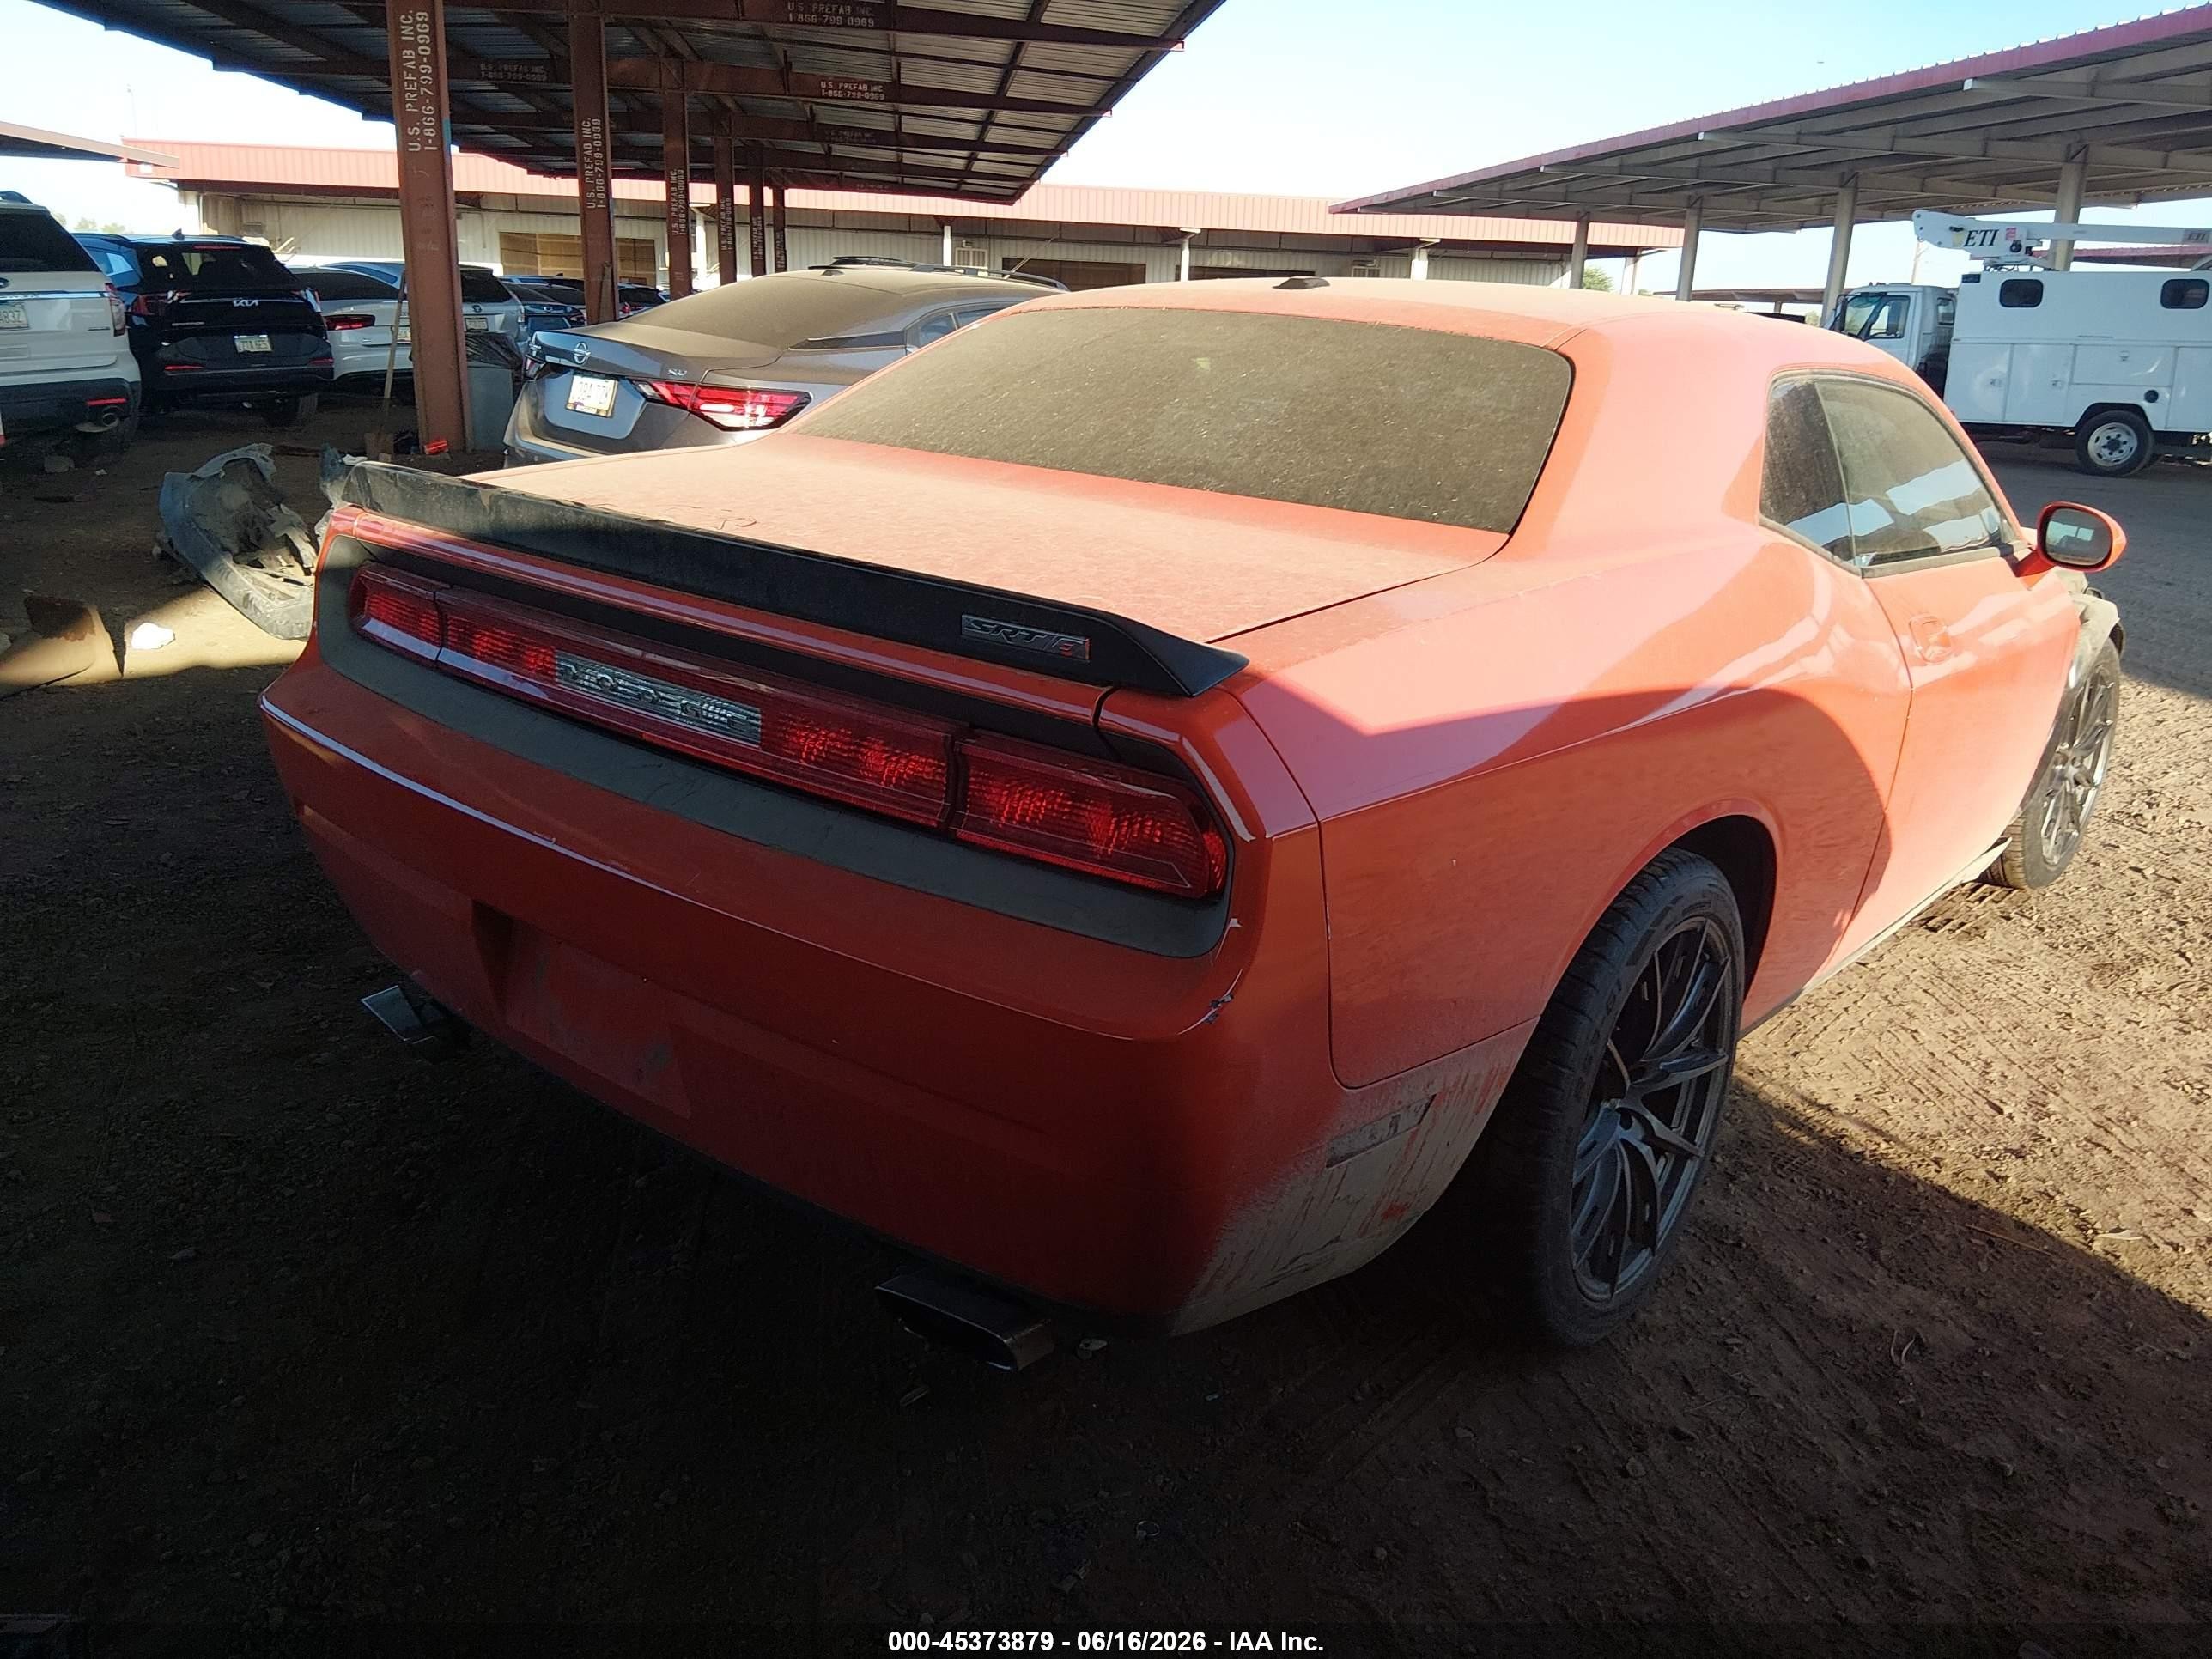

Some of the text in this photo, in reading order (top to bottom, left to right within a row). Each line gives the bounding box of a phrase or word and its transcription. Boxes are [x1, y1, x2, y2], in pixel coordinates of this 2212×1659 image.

[399, 10, 422, 152] U.S. PREFAB INC.
[416, 11, 439, 151] 1-866-799-0969
[583, 143, 595, 184] PREFAB
[1963, 228, 2000, 248] ETI
